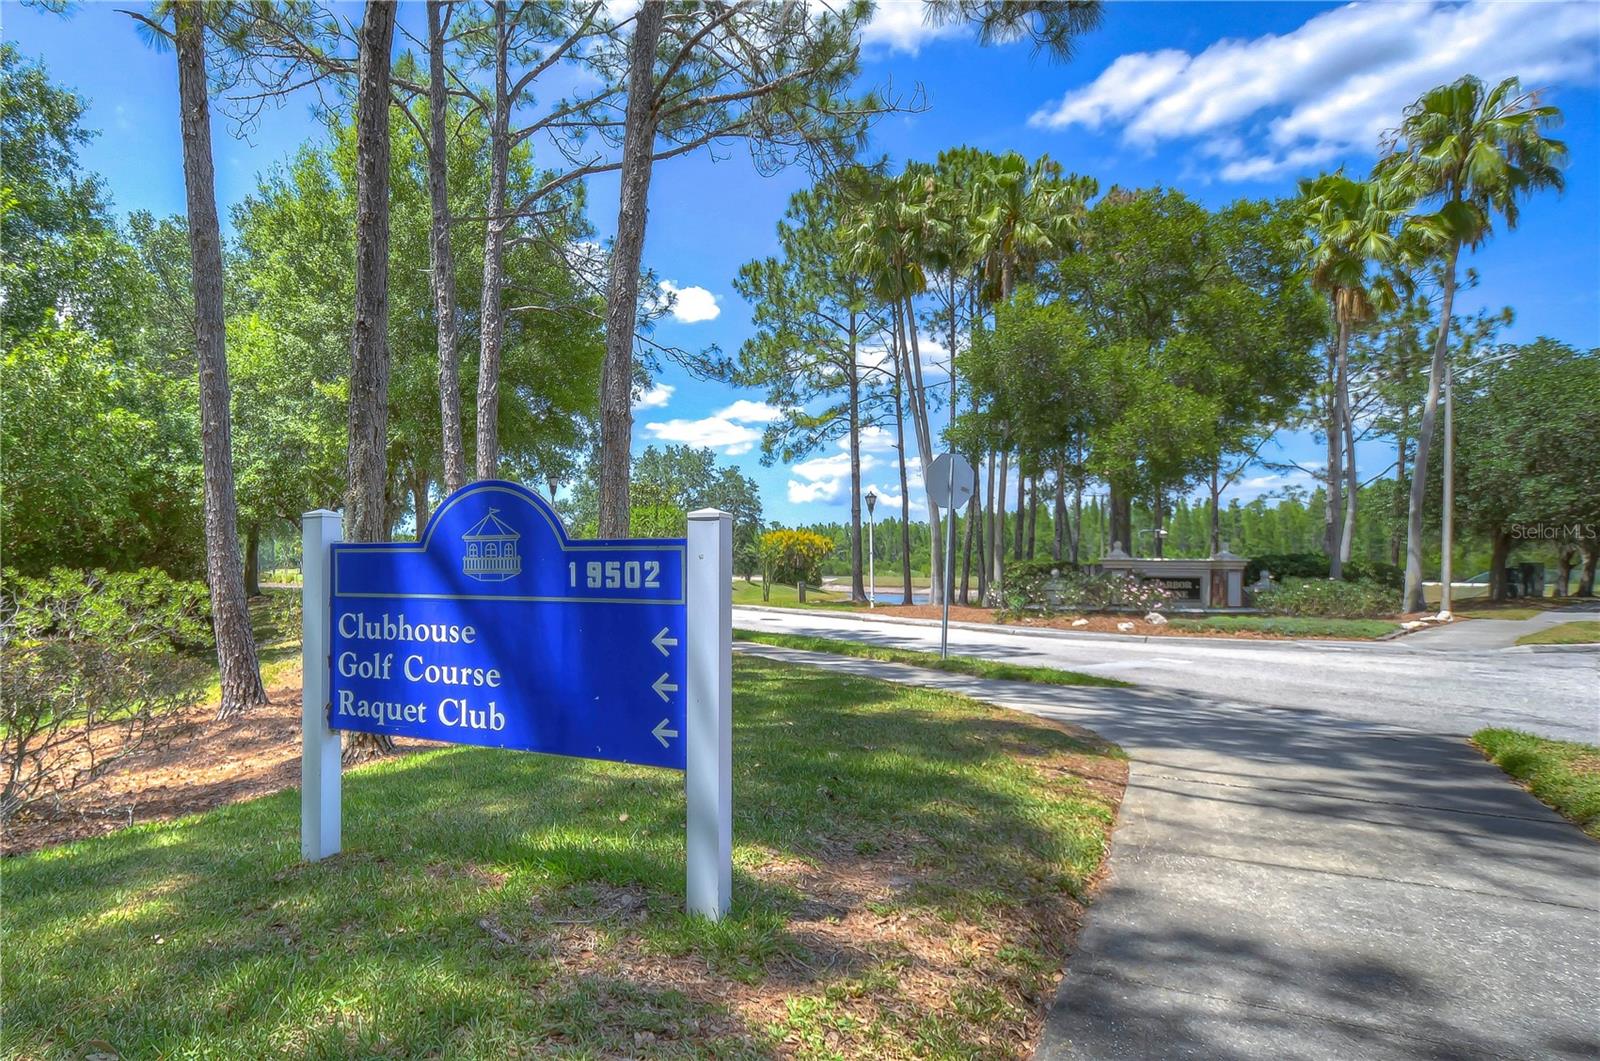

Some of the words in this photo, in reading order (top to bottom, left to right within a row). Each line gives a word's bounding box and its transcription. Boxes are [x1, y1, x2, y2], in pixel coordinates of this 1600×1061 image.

[569, 561, 660, 588] 19502
[338, 612, 477, 644] Clubhouse
[338, 651, 394, 680] Golf
[403, 654, 501, 688] Course
[338, 689, 427, 726] Raquet
[437, 697, 506, 731] Club
